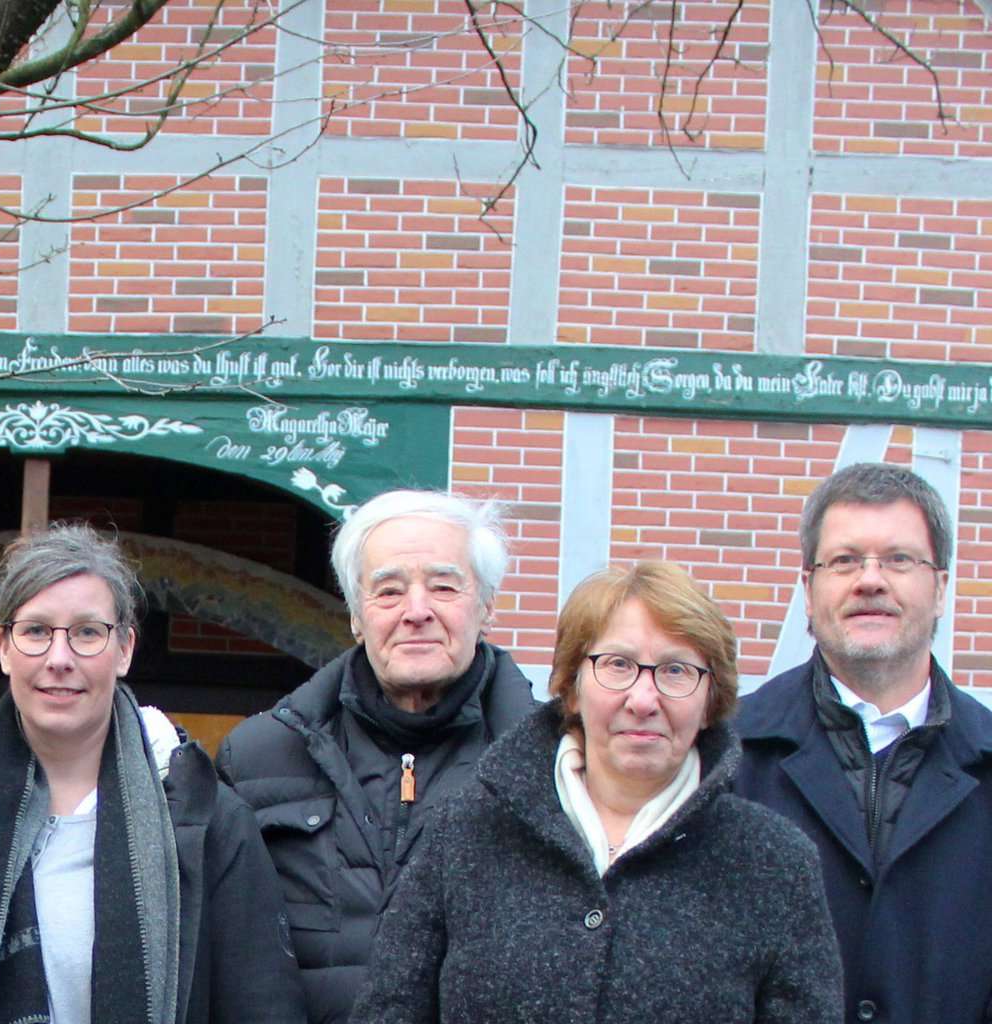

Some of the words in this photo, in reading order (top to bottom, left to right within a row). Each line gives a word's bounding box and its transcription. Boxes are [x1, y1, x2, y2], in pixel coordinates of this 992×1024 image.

[123, 348, 155, 373] alles
[158, 357, 190, 374] was
[193, 347, 211, 374] du
[253, 352, 268, 381] ist
[344, 353, 364, 379] dir
[367, 356, 382, 384] ist
[384, 356, 424, 389] nichts
[501, 367, 530, 383] was
[535, 359, 560, 390] soll
[561, 360, 580, 395] ich
[712, 363, 733, 391] da
[732, 364, 753, 392] du
[758, 373, 791, 394] mein
[948, 382, 972, 401] mir
